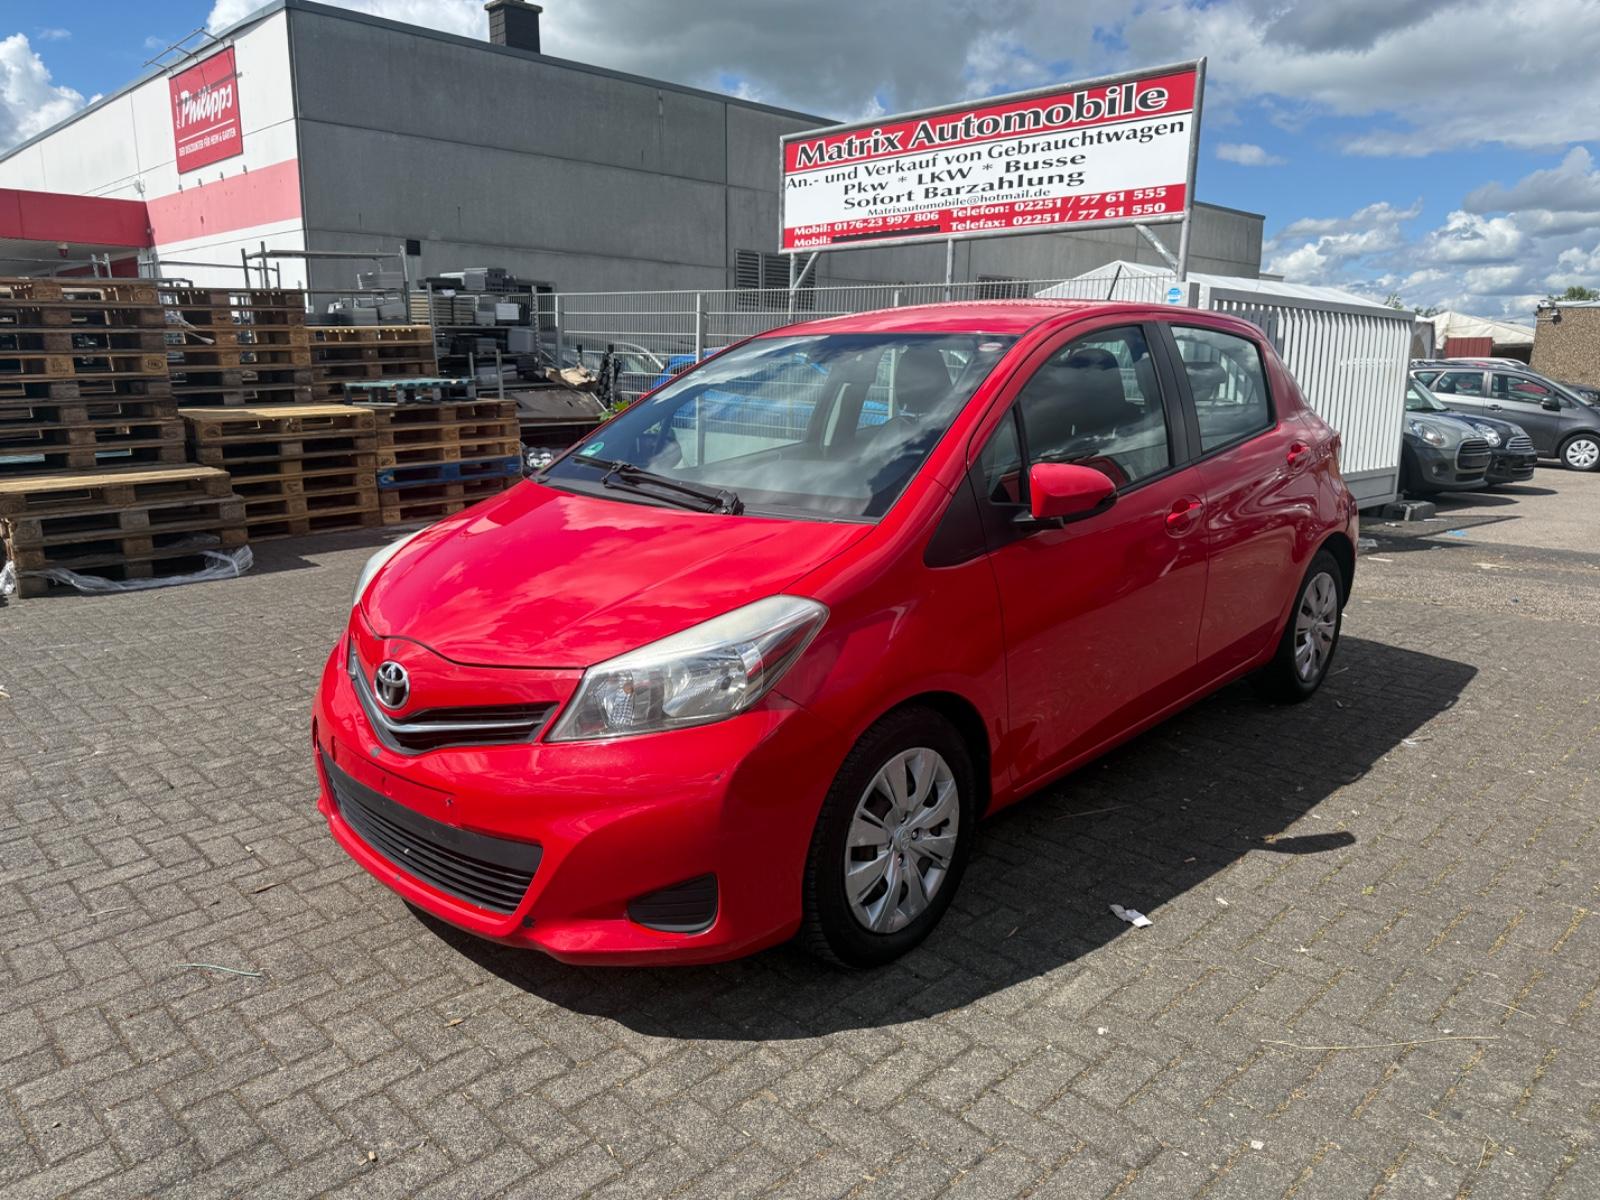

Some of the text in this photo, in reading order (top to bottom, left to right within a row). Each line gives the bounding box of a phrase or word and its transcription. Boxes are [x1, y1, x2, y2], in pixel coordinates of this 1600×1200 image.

[180, 84, 233, 128] Philipps
[797, 83, 1168, 167] Matrix Automobile
[787, 120, 1184, 190] An.- und Verkauf von Gebrauchtwagen
[843, 170, 1085, 210] Sofort Barzahlung
[844, 180, 889, 195] Pkw
[917, 166, 973, 186] LKW
[1005, 154, 1086, 173] Busse
[867, 188, 1051, 217] Matrixautomobile@hotmail.de
[950, 218, 1006, 232] Telefax:
[1012, 213, 1060, 225] 02251
[1078, 208, 1099, 220] 77
[1105, 205, 1124, 217] 61
[1132, 202, 1166, 214] 550
[951, 204, 1009, 219] Telefon:
[1014, 200, 1062, 213] 02251
[1079, 194, 1101, 206] 77
[1106, 191, 1125, 202] 61
[1133, 187, 1167, 200] 555
[794, 223, 831, 236] Mobil:
[834, 217, 882, 232] 0176-23
[887, 214, 910, 225] 997
[914, 211, 939, 223] 806
[793, 236, 831, 248] Mobil:
